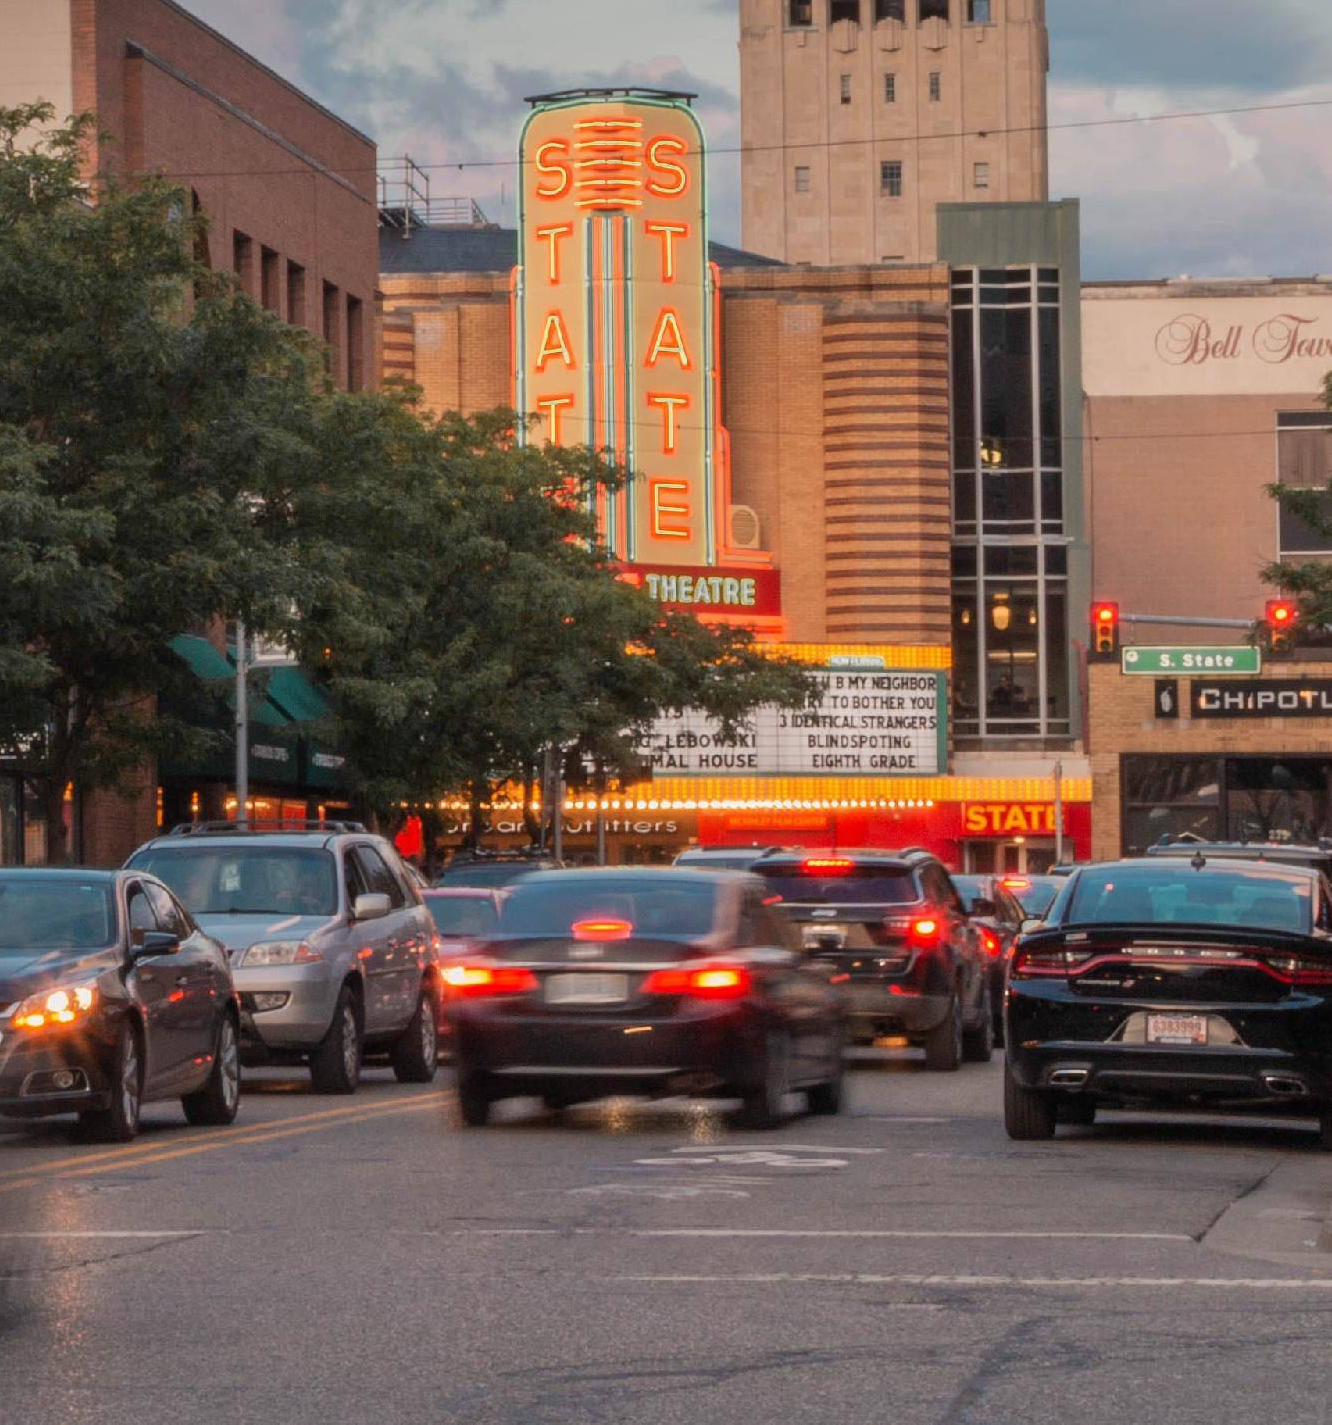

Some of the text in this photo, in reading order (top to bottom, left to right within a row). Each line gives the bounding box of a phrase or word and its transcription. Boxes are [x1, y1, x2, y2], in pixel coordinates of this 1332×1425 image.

[535, 140, 575, 540] STAT
[647, 137, 689, 538] STATE
[1155, 313, 1242, 366] Bell
[647, 575, 756, 606] THEATRE
[1159, 653, 1234, 668] S. State
[848, 677, 868, 690] MY
[872, 677, 936, 691] NEIGHBOR
[831, 696, 849, 709] TO
[853, 696, 905, 710] BOTHER
[910, 696, 936, 710] YOU
[779, 715, 936, 729] 3 IDENTICAL STRANGERS
[807, 734, 911, 749] BLINDSPOTING
[699, 754, 758, 768] HOUSE
[812, 754, 916, 768] EIGHTH GRADE
[966, 804, 1064, 831] STATE
